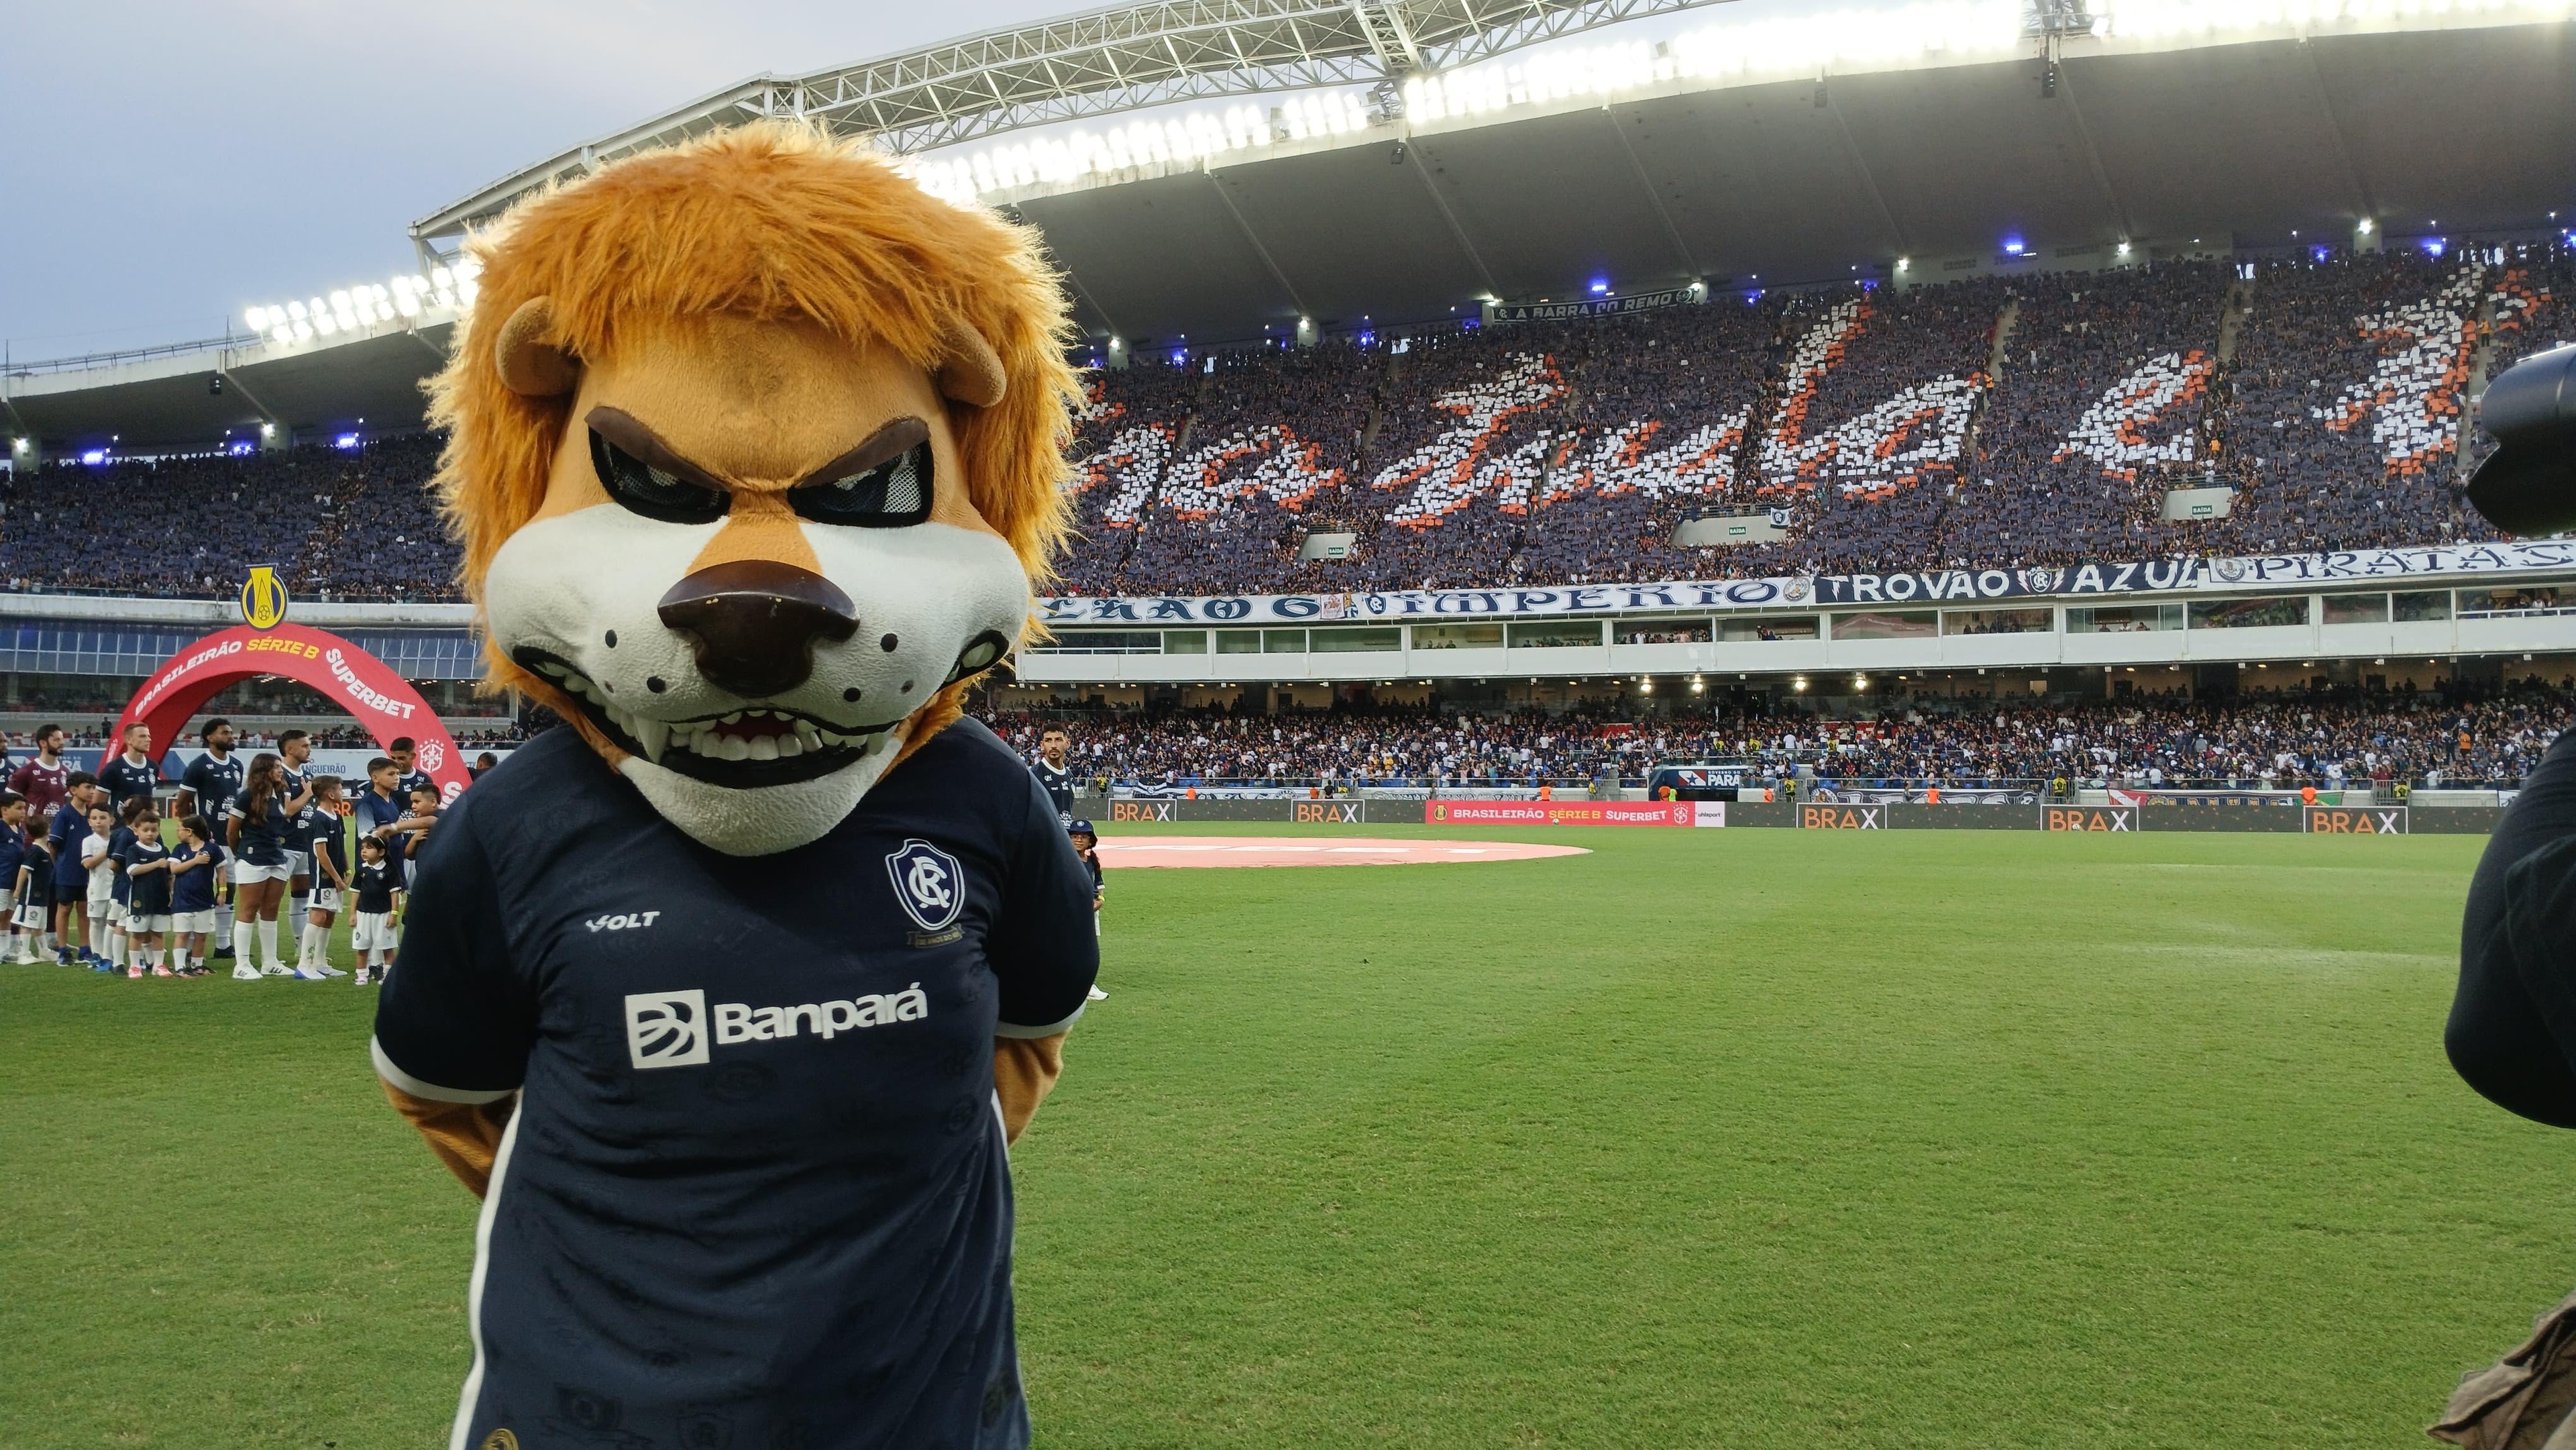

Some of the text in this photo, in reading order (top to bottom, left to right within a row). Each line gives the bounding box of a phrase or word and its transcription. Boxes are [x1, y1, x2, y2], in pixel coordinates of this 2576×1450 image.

[1516, 308, 1527, 319] A
[1533, 304, 1589, 318] BARRA
[1624, 293, 1672, 311] REMO
[2249, 543, 2575, 579] PIRATAS
[1823, 569, 2009, 601] TROVÃO
[2072, 558, 2199, 593] AZUL
[136, 636, 415, 719] BRASILEIRÃO SÉRIE B SUPERBET
[302, 763, 346, 774] ANGUEIRÃO
[1114, 804, 1171, 822] BRAX
[1297, 804, 1357, 823] BRAX
[1454, 807, 1667, 822] BRASILEIRÃO SÉRIE B SUPERBET
[1805, 808, 1879, 829] BRAX
[2049, 810, 2130, 832] BRAX
[2312, 811, 2398, 834] BRAX
[585, 911, 661, 933] VOLT
[713, 982, 928, 1044] Banpará
